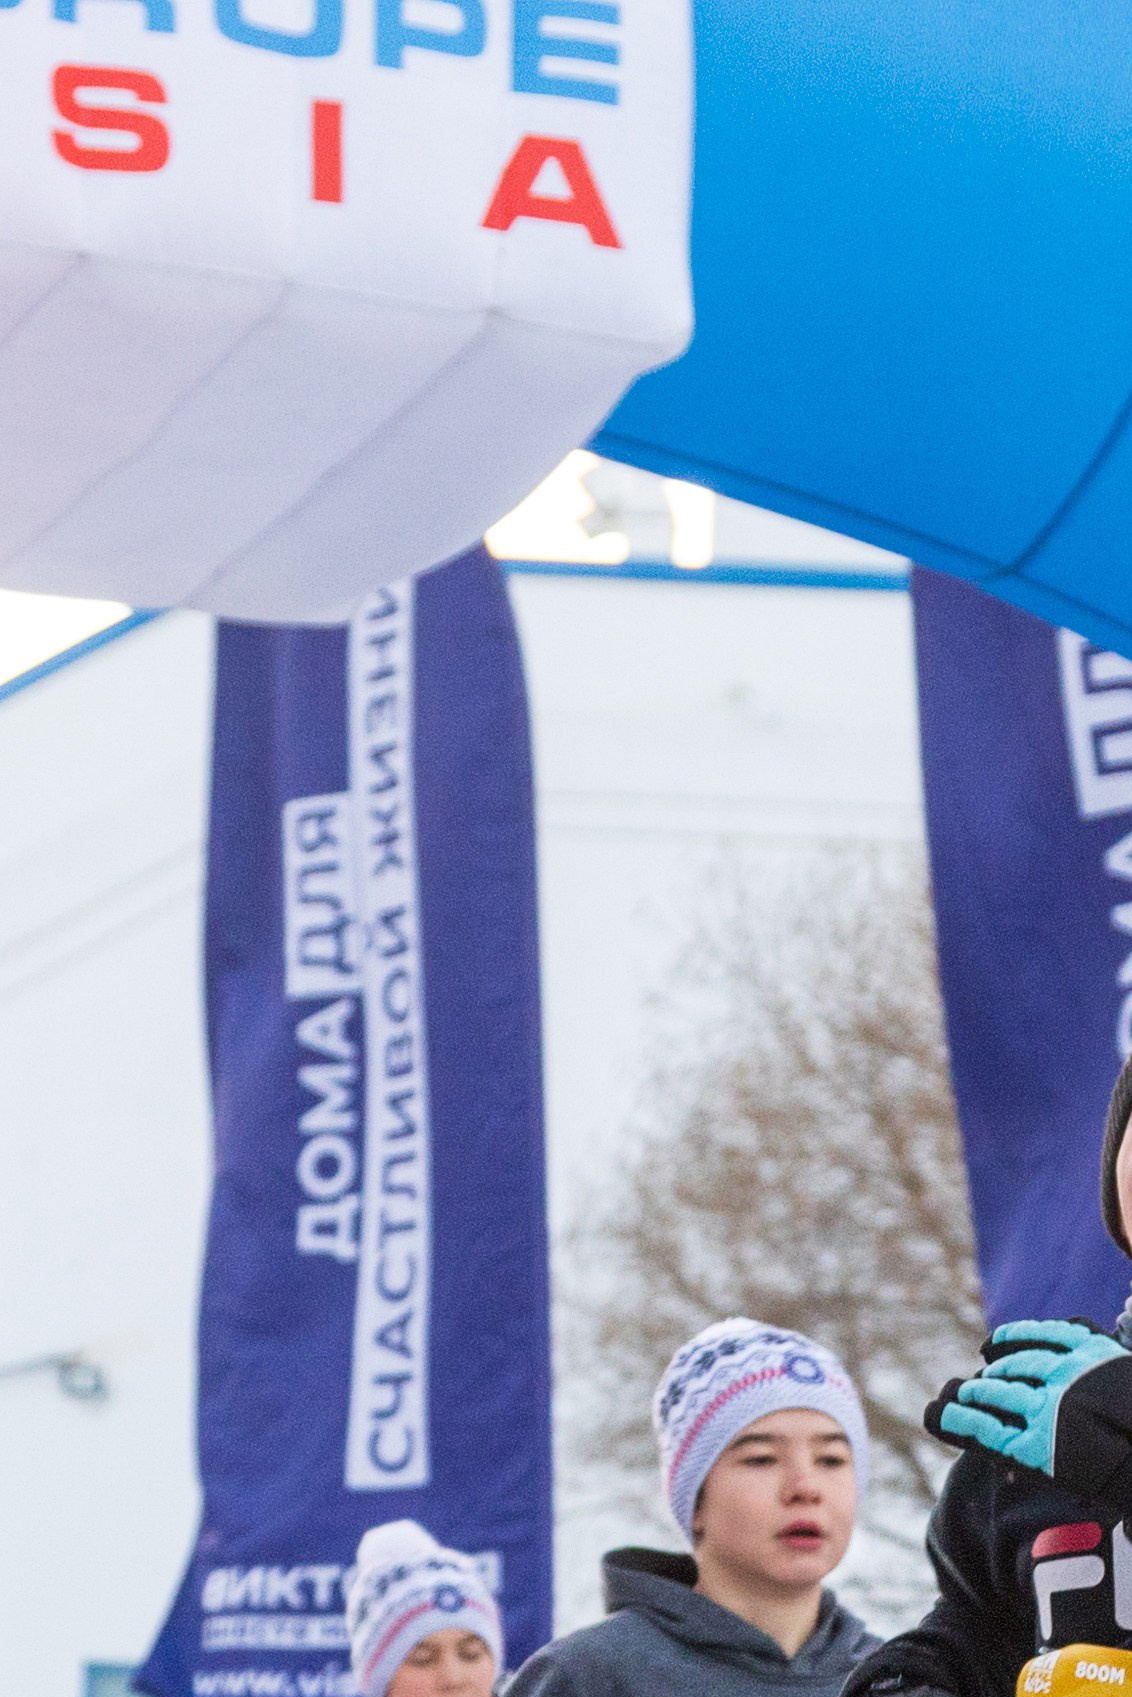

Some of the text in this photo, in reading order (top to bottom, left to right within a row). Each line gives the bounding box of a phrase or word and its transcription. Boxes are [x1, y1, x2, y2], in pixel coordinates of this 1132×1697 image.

[296, 805, 361, 1262] ДОМА ДЛЯ
[363, 904, 417, 1473] СЧАСТЛИВОЙ
